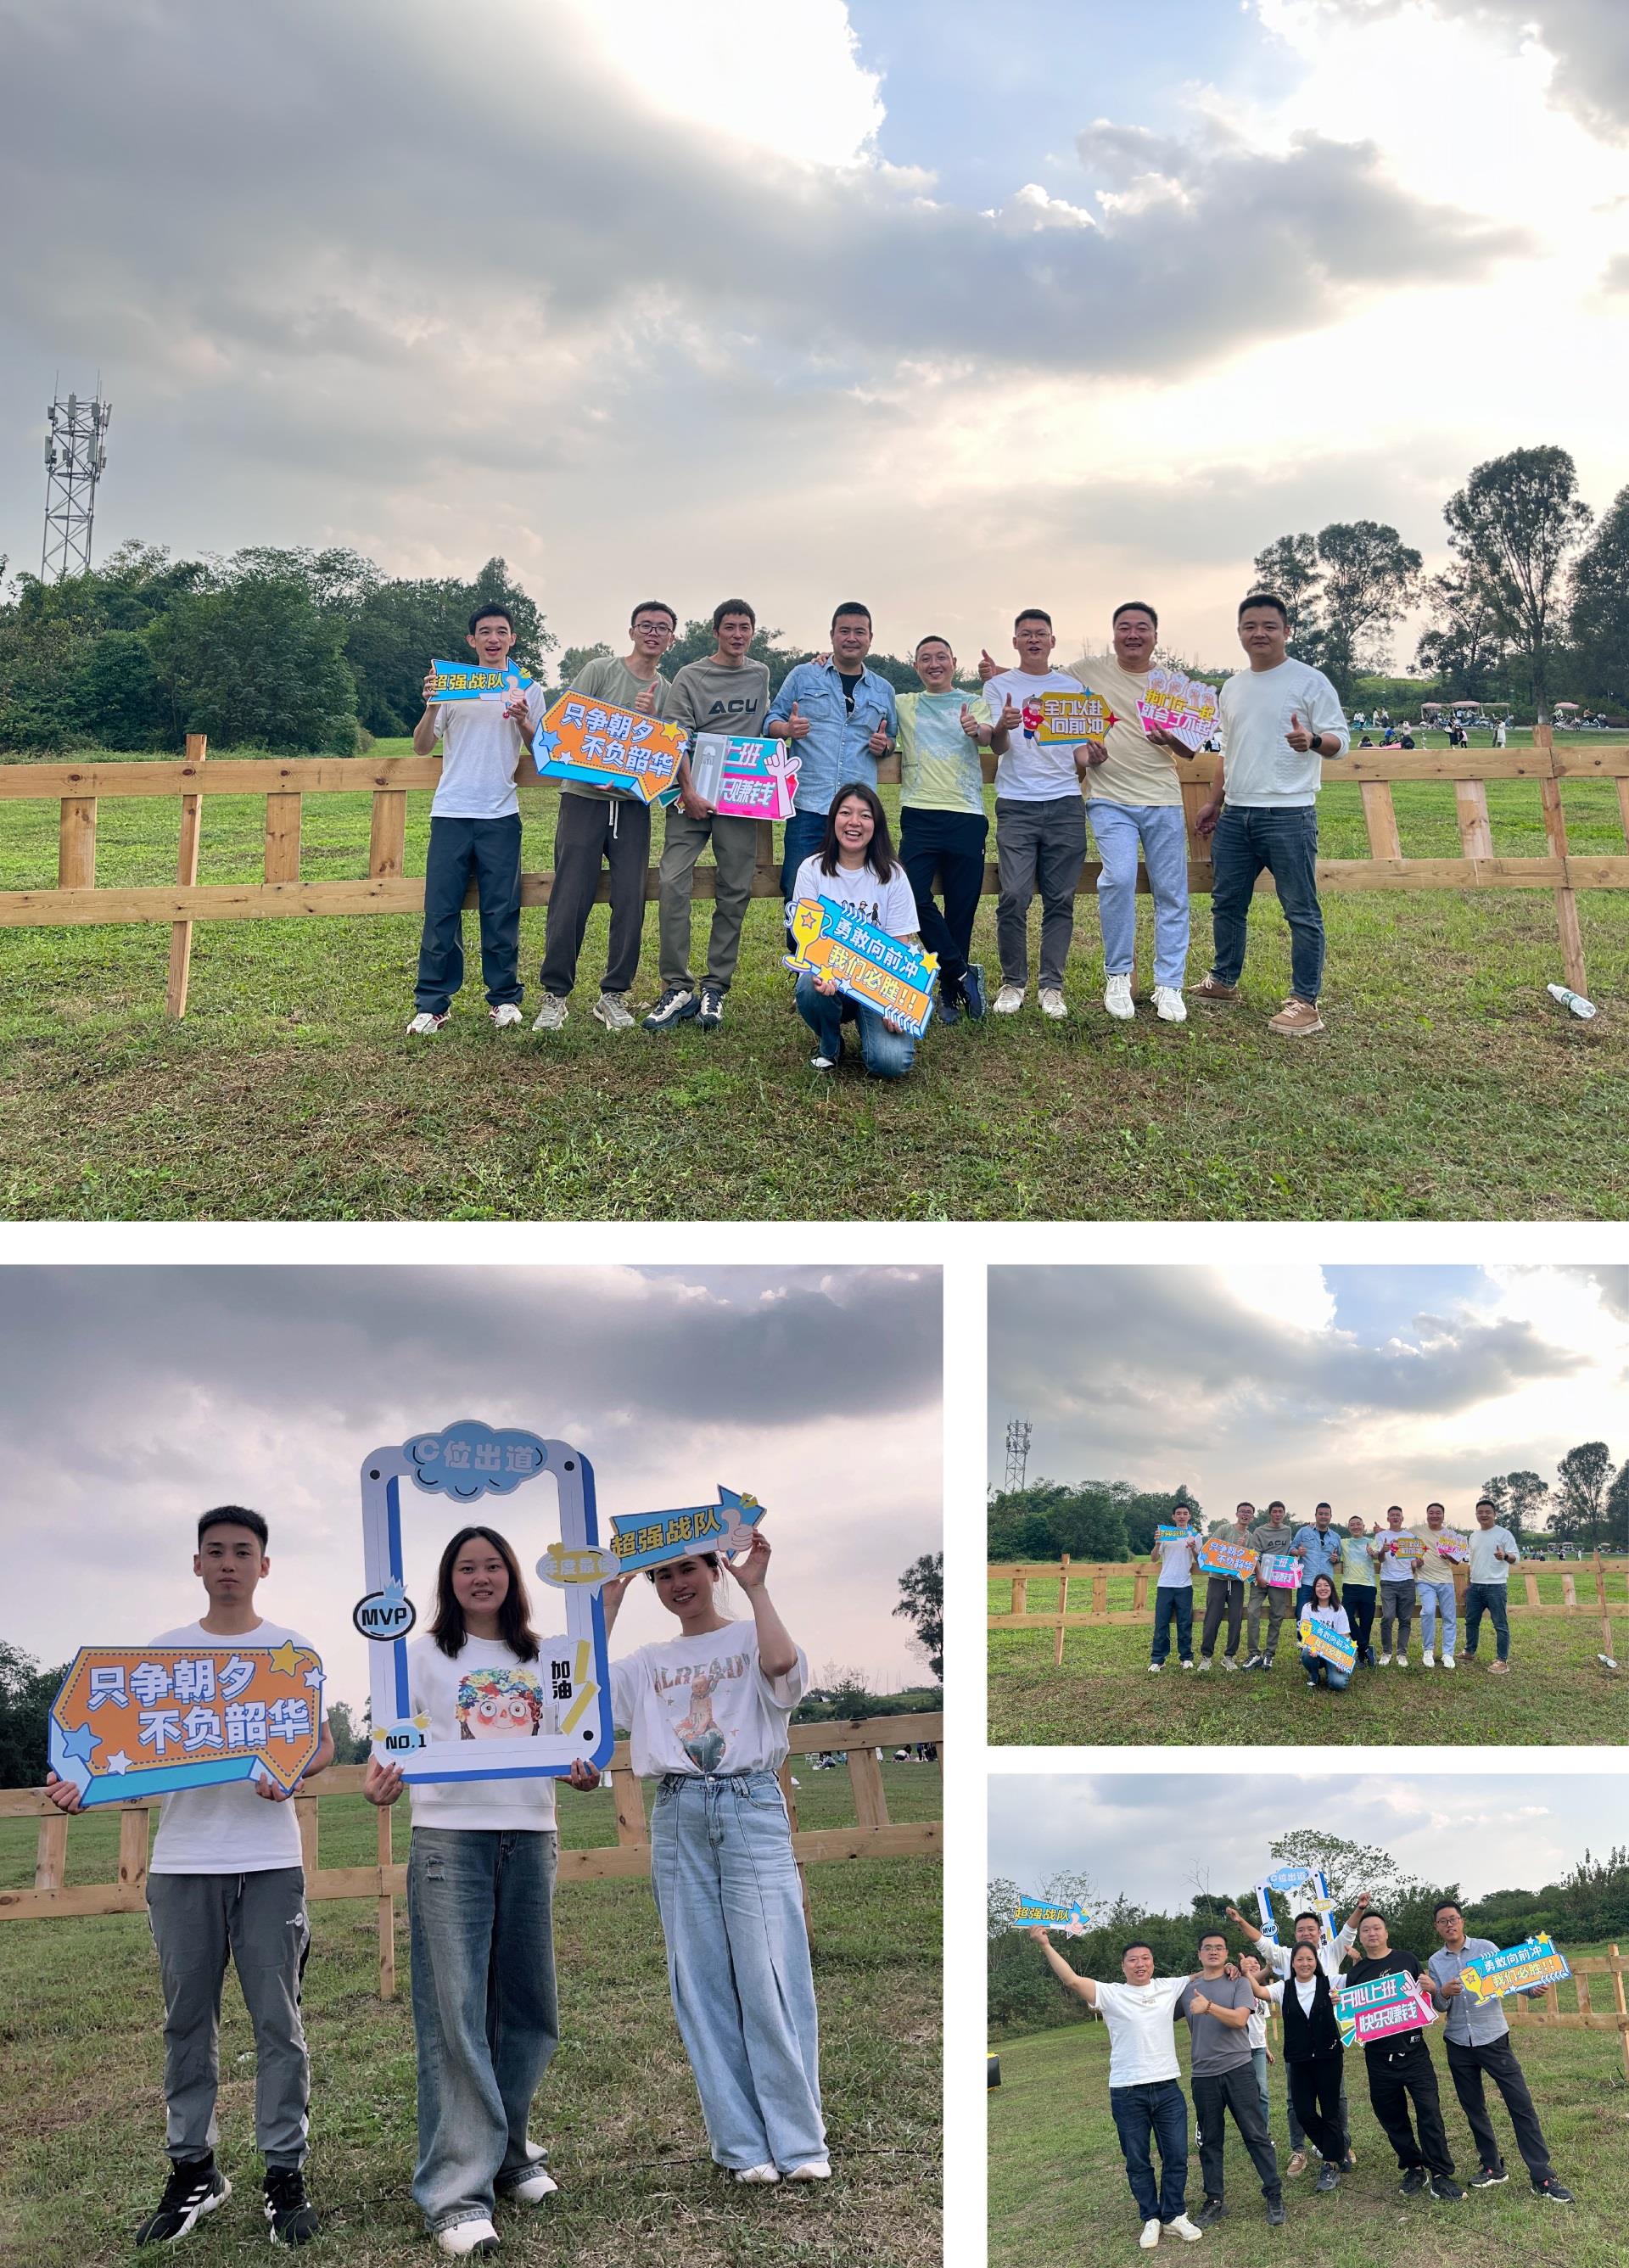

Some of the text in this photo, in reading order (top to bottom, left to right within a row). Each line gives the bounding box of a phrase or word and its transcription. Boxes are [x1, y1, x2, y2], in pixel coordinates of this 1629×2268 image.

[428, 671, 506, 691] 超强战队
[708, 698, 759, 715] ACU
[1044, 699, 1104, 717] 全力以赴
[1140, 703, 1212, 736] 就会了不起
[1145, 689, 1216, 720] 我们在一起
[560, 702, 654, 744] 只争朝夕
[1051, 717, 1104, 735] 向前冲
[580, 734, 674, 778] 不负韶华
[833, 916, 920, 981] 勇敢向前冲
[417, 1438, 534, 1474] C位出道
[609, 1507, 722, 1559] 超强战队
[361, 1607, 407, 1627] MVP
[87, 1655, 257, 1712] 只争朝夕
[551, 1660, 573, 1700] 加油
[137, 1697, 312, 1756] 不负韶华
[385, 1733, 427, 1750] NO.1
[1014, 1907, 1070, 1922] 超强战队
[1262, 1925, 1276, 1935] MVP
[1484, 1945, 1542, 1973] 勇敢向前冲
[1341, 1978, 1397, 2012] 开心上班
[1358, 2000, 1419, 2034] 快乐赚钱
